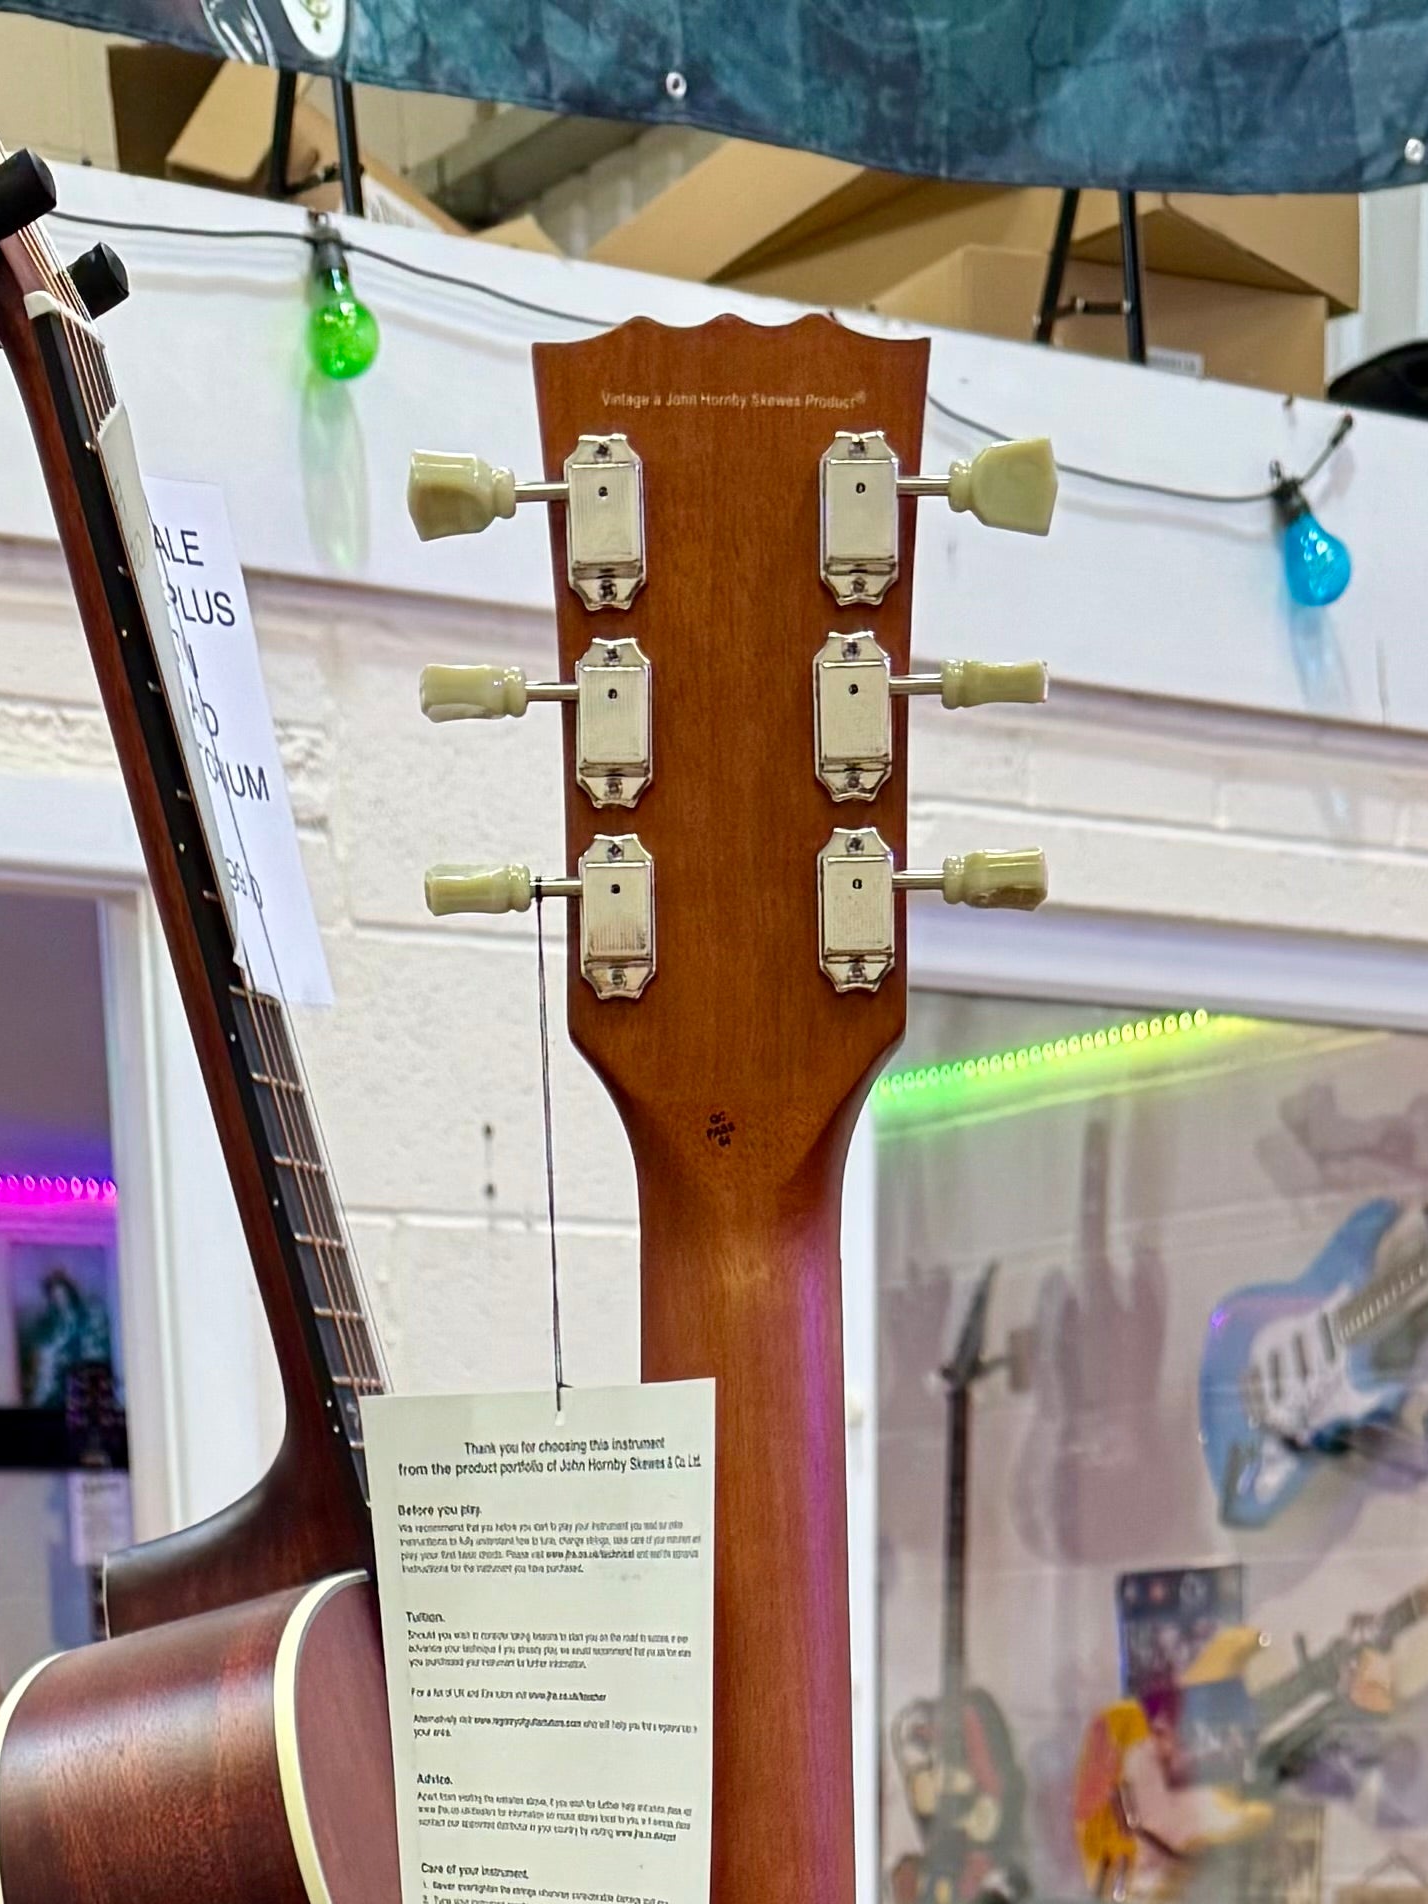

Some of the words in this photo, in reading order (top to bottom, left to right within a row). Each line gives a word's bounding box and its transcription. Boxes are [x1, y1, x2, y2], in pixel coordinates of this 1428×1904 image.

[601, 390, 650, 408] Vintage
[665, 391, 697, 406] John
[701, 391, 747, 409] Hornby
[751, 392, 801, 408] Skewes
[153, 525, 204, 567] ALE
[464, 1442, 495, 1456] Thank
[500, 1442, 519, 1457] you
[521, 1441, 536, 1454] for
[538, 1439, 587, 1454] choosing
[589, 1438, 609, 1452] this
[612, 1437, 665, 1451] instrument
[398, 1463, 426, 1476] from
[431, 1462, 452, 1476] the
[456, 1461, 497, 1478] product
[500, 1459, 544, 1477] portfolio
[559, 1457, 585, 1472] John
[588, 1456, 627, 1474] Hornby
[437, 1505, 457, 1518] you
